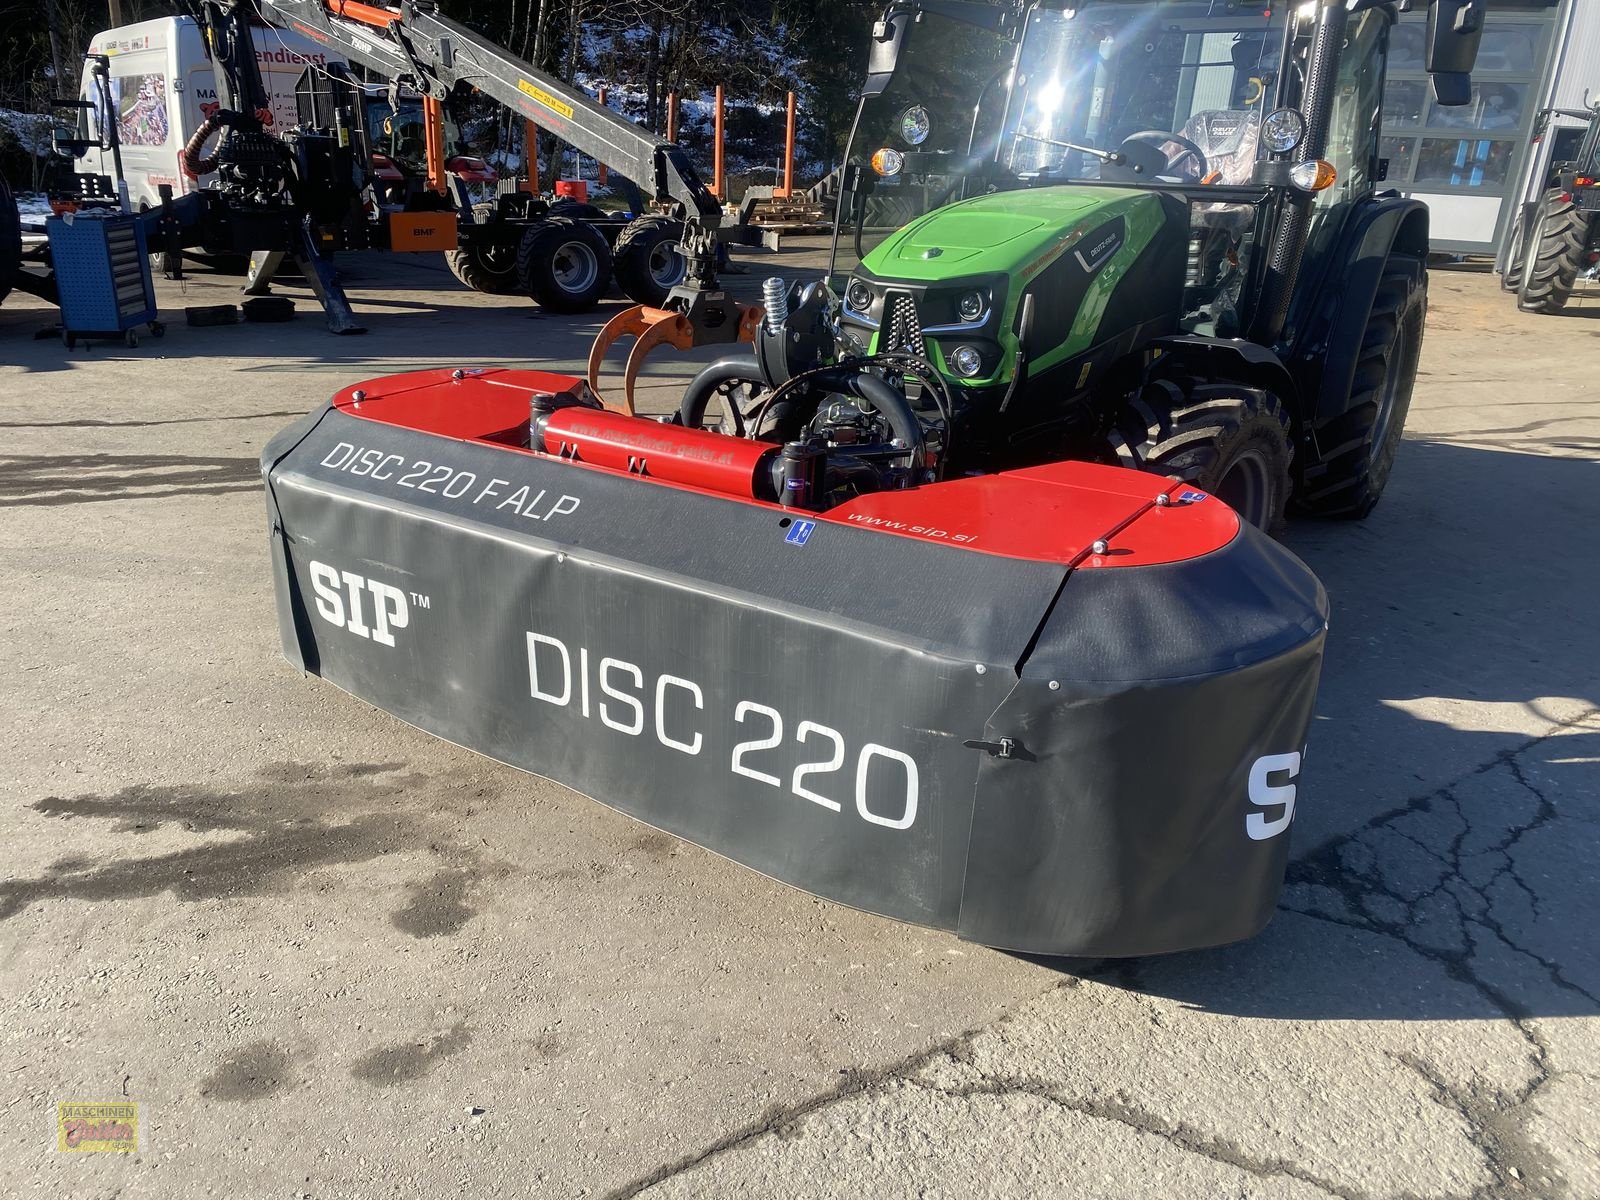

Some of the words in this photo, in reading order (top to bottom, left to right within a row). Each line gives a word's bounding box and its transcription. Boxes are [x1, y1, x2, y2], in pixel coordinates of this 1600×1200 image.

[413, 228, 435, 236] BMF
[320, 442, 403, 481] DISC
[397, 460, 477, 499] 220
[847, 512, 978, 544] www.sip.si
[309, 560, 409, 648] SIP
[526, 631, 704, 755] DISC
[731, 700, 919, 829] 220
[1246, 751, 1301, 841] S
